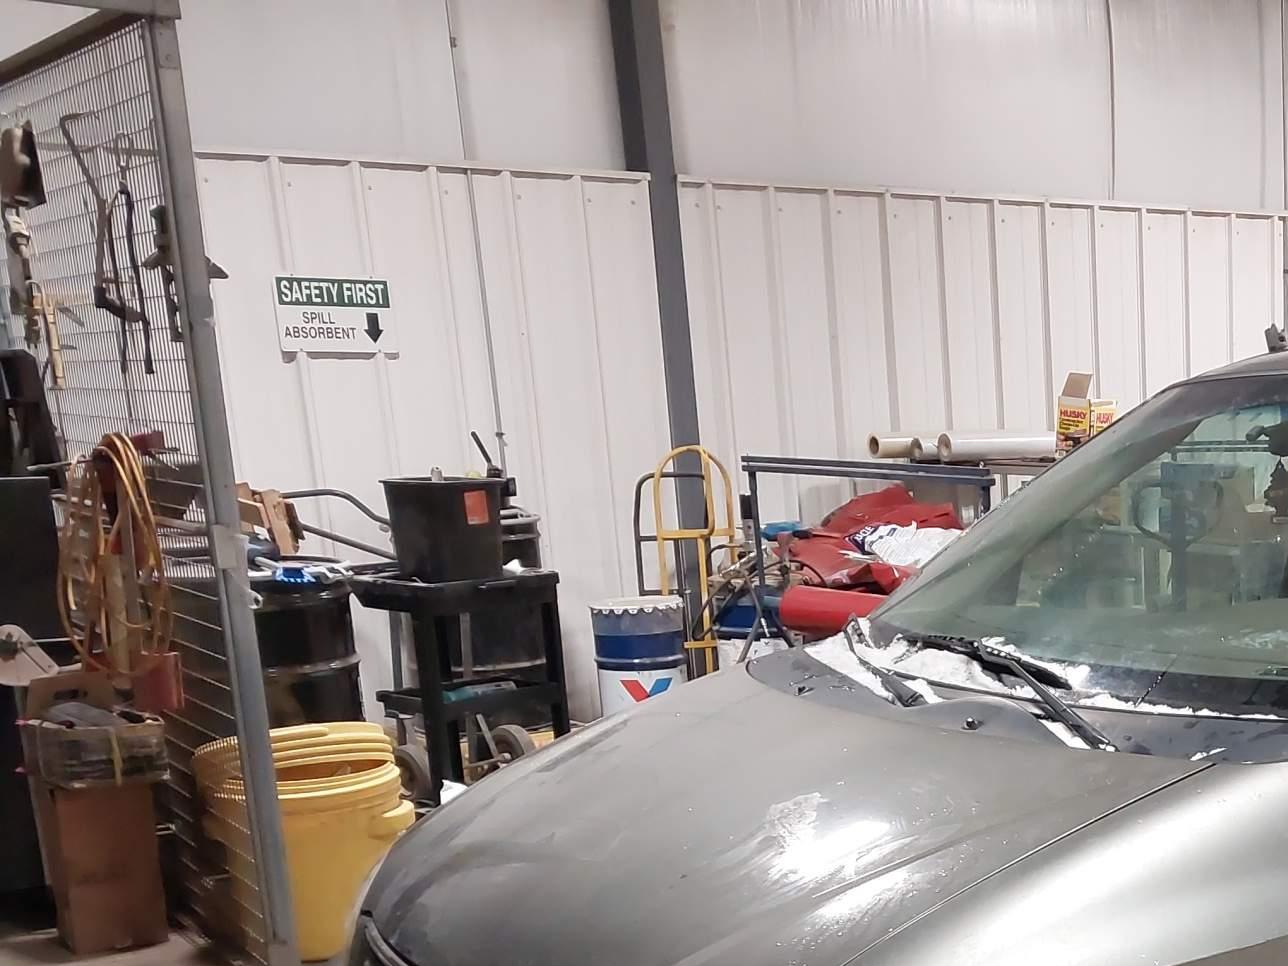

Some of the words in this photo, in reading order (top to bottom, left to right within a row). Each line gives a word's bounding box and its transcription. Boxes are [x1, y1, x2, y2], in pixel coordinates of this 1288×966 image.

[280, 280, 338, 303] SAFETY
[342, 282, 384, 305] FIRST
[302, 311, 336, 325] SPILL
[284, 326, 357, 340] ABSORBENT
[1060, 408, 1087, 419] HUSKY
